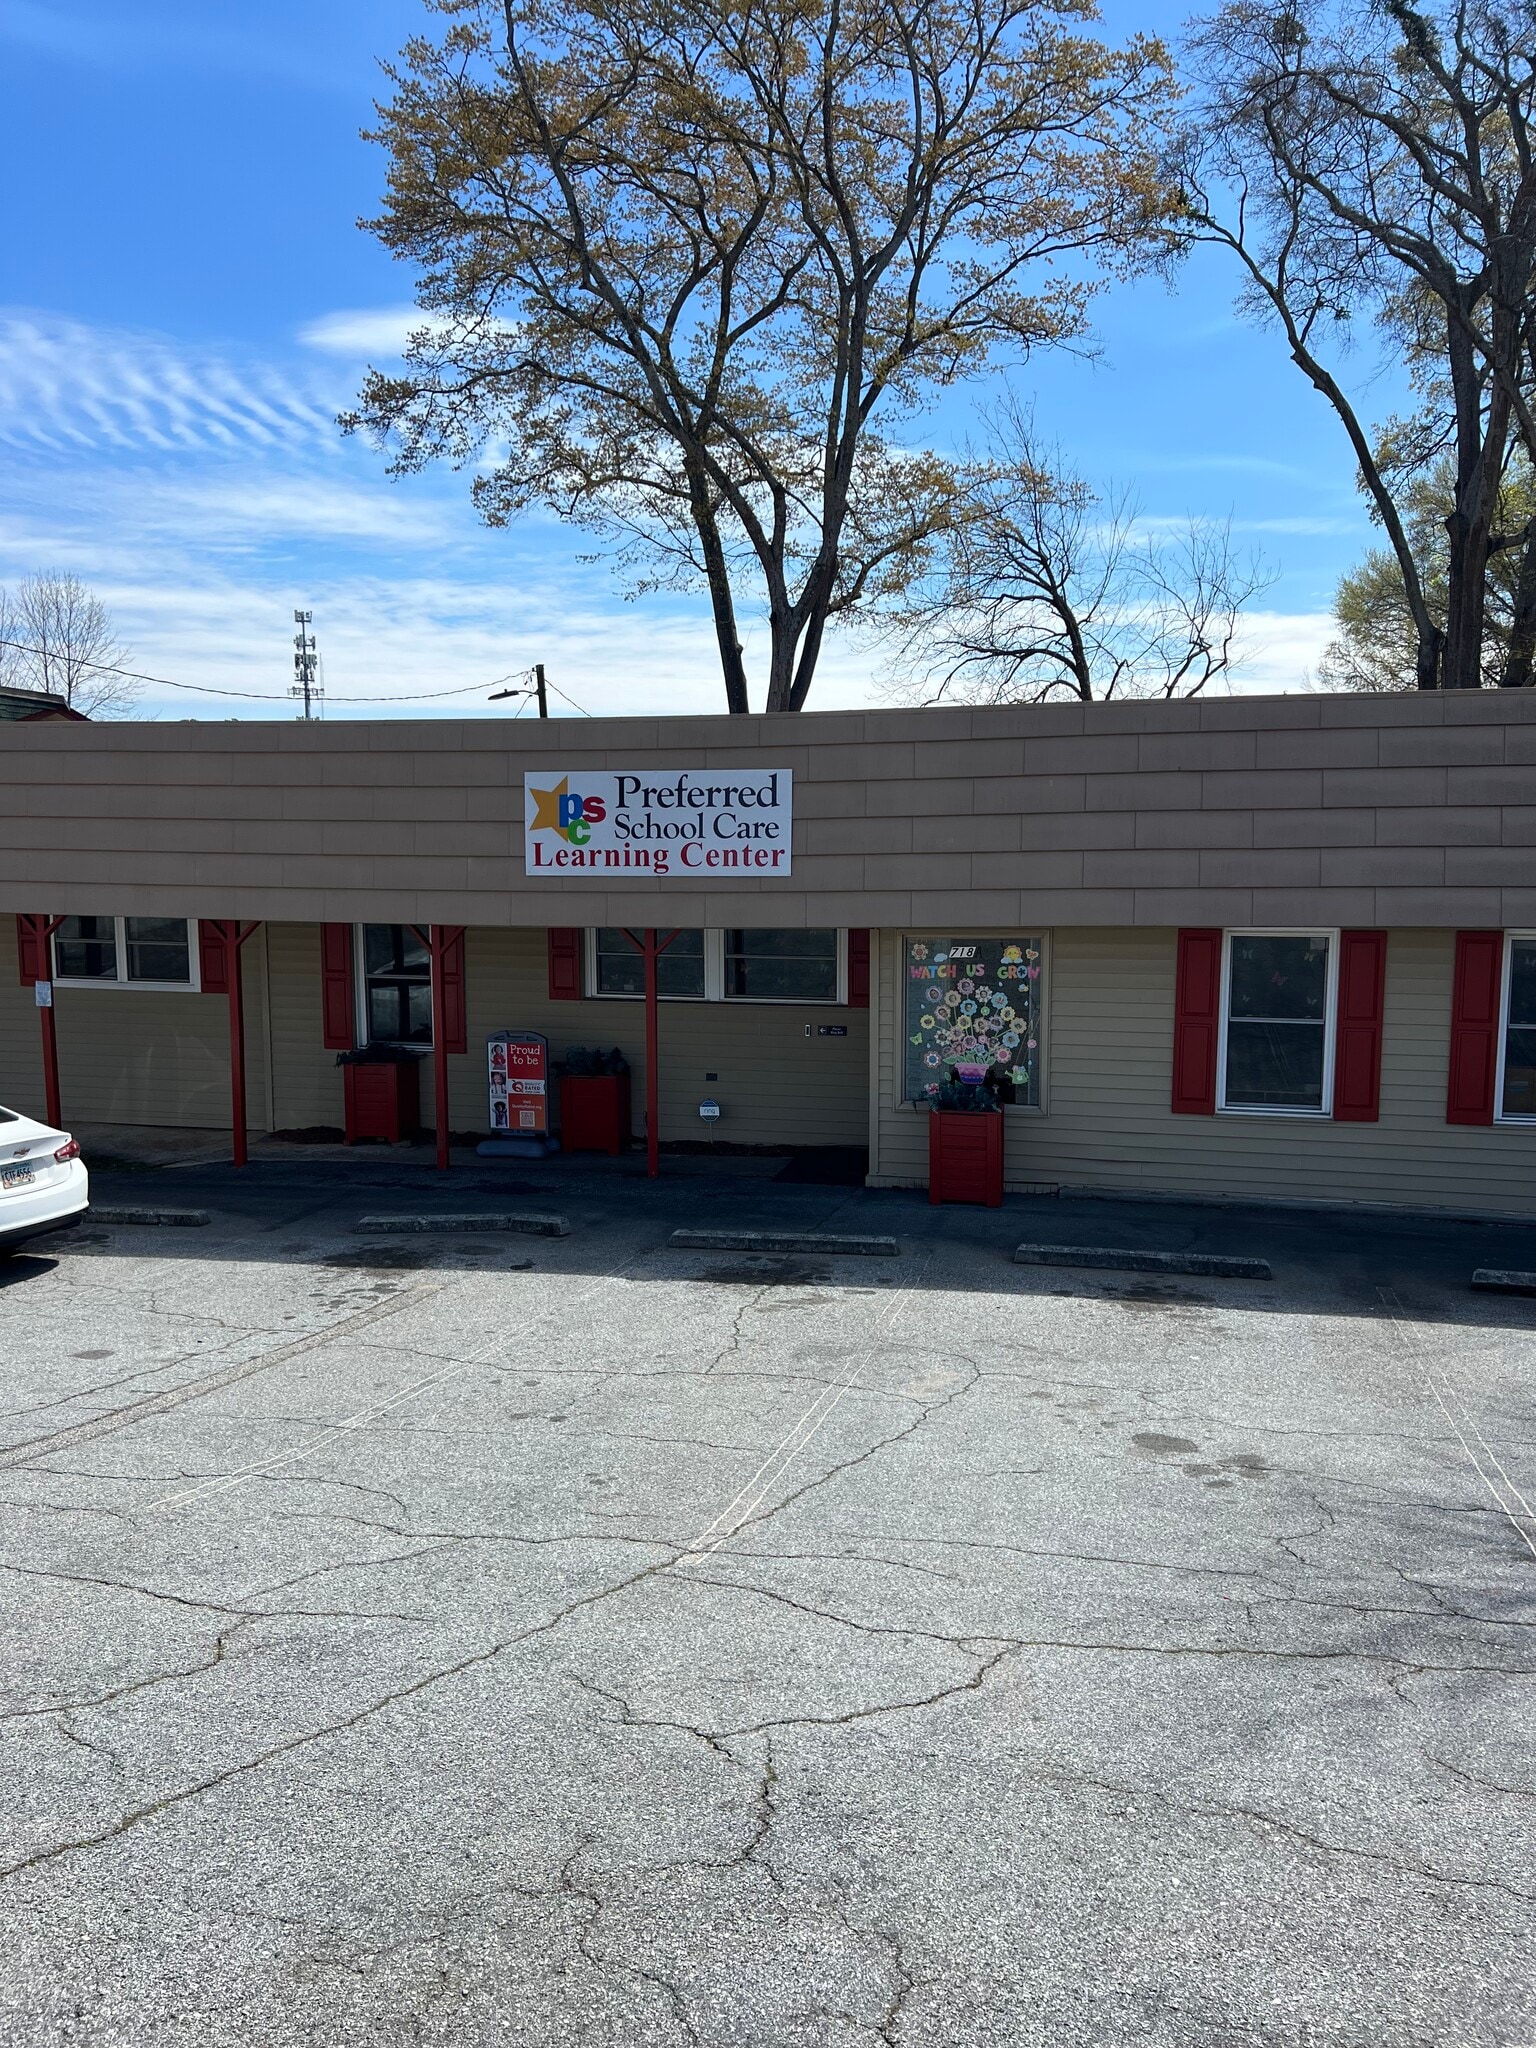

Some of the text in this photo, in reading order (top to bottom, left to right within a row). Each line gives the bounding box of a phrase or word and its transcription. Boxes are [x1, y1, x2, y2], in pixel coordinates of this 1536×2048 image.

[614, 773, 781, 809] Preferred
[614, 812, 780, 840] School Care
[532, 842, 786, 875] Learning Center
[910, 963, 1040, 980] WATCH US GROW
[510, 1044, 541, 1056] Proud
[512, 1054, 539, 1065] to be
